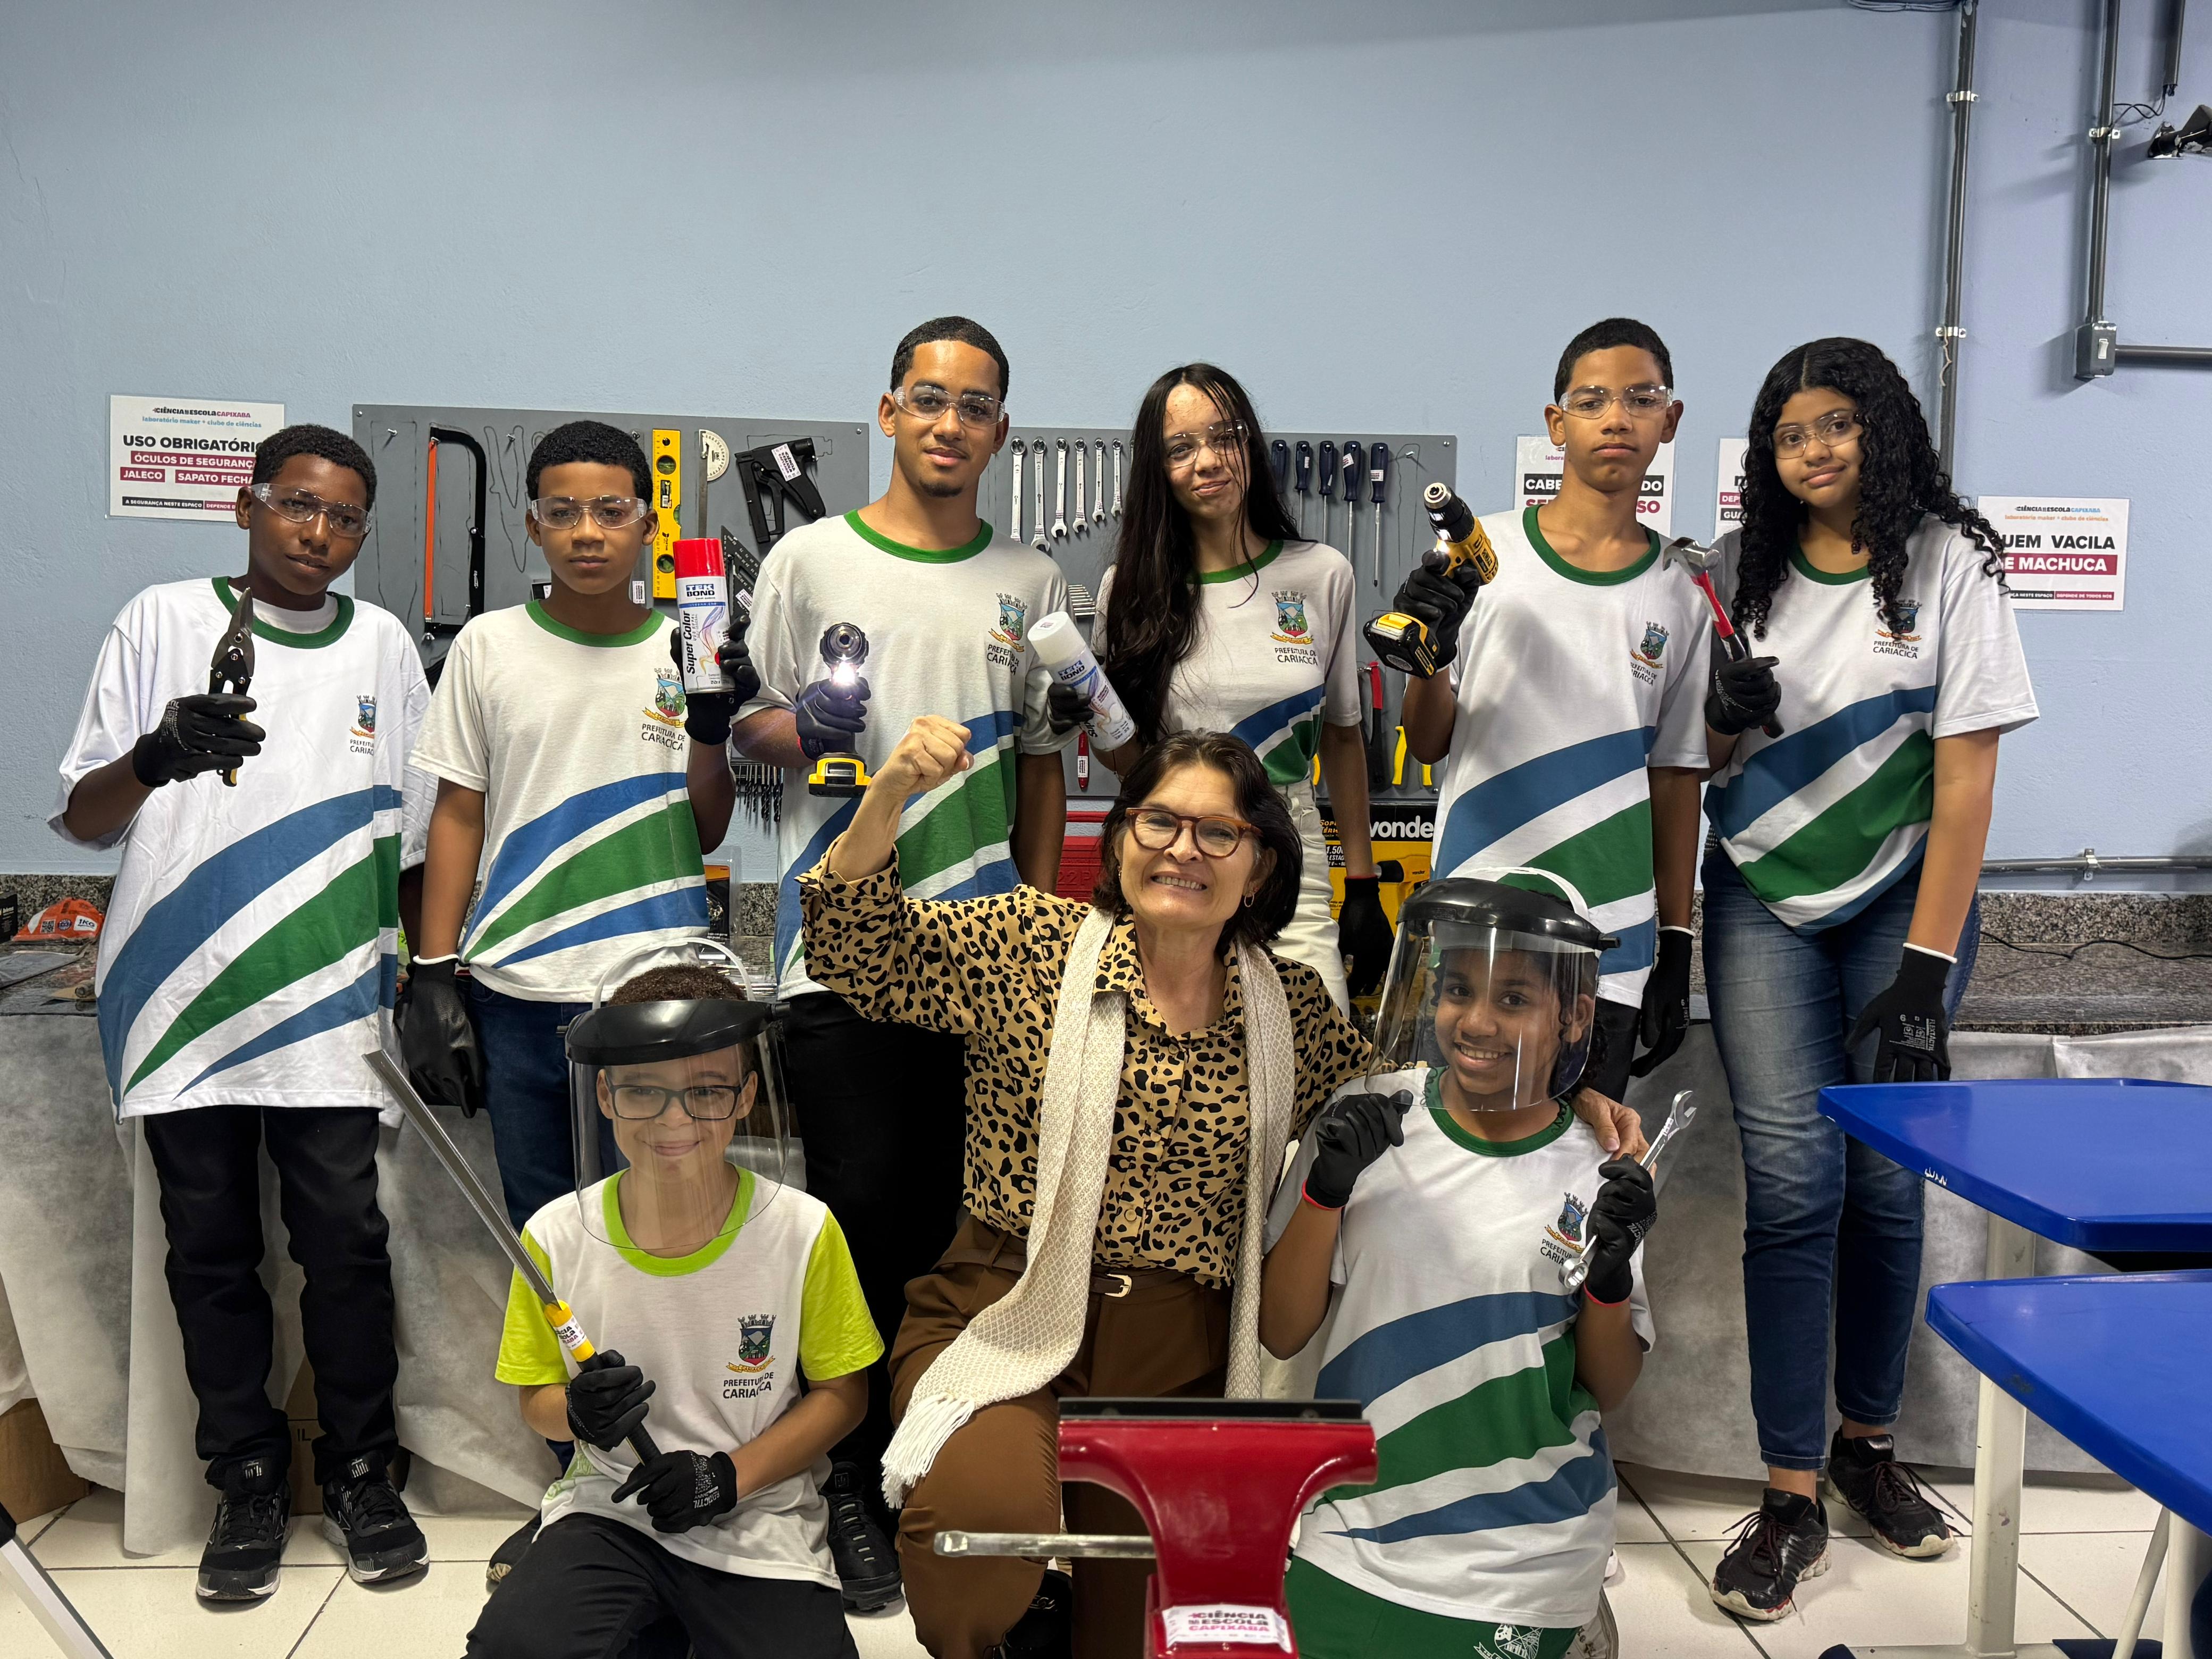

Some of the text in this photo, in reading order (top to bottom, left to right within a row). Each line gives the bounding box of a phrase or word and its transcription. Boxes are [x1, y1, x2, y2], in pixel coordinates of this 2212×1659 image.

[123, 434, 156, 448] USO
[134, 453, 178, 464] ÓCULOS
[179, 457, 193, 465] DE
[123, 470, 163, 480] JALECO
[178, 473, 219, 483] SAPATO
[2002, 534, 2116, 549] UEM VACILA
[2018, 557, 2107, 572] MACHUCA
[683, 610, 697, 675] Super Color
[1873, 646, 1917, 659] CARIACICA
[1370, 815, 1434, 839] vonde
[79, 918, 95, 927] 1KG
